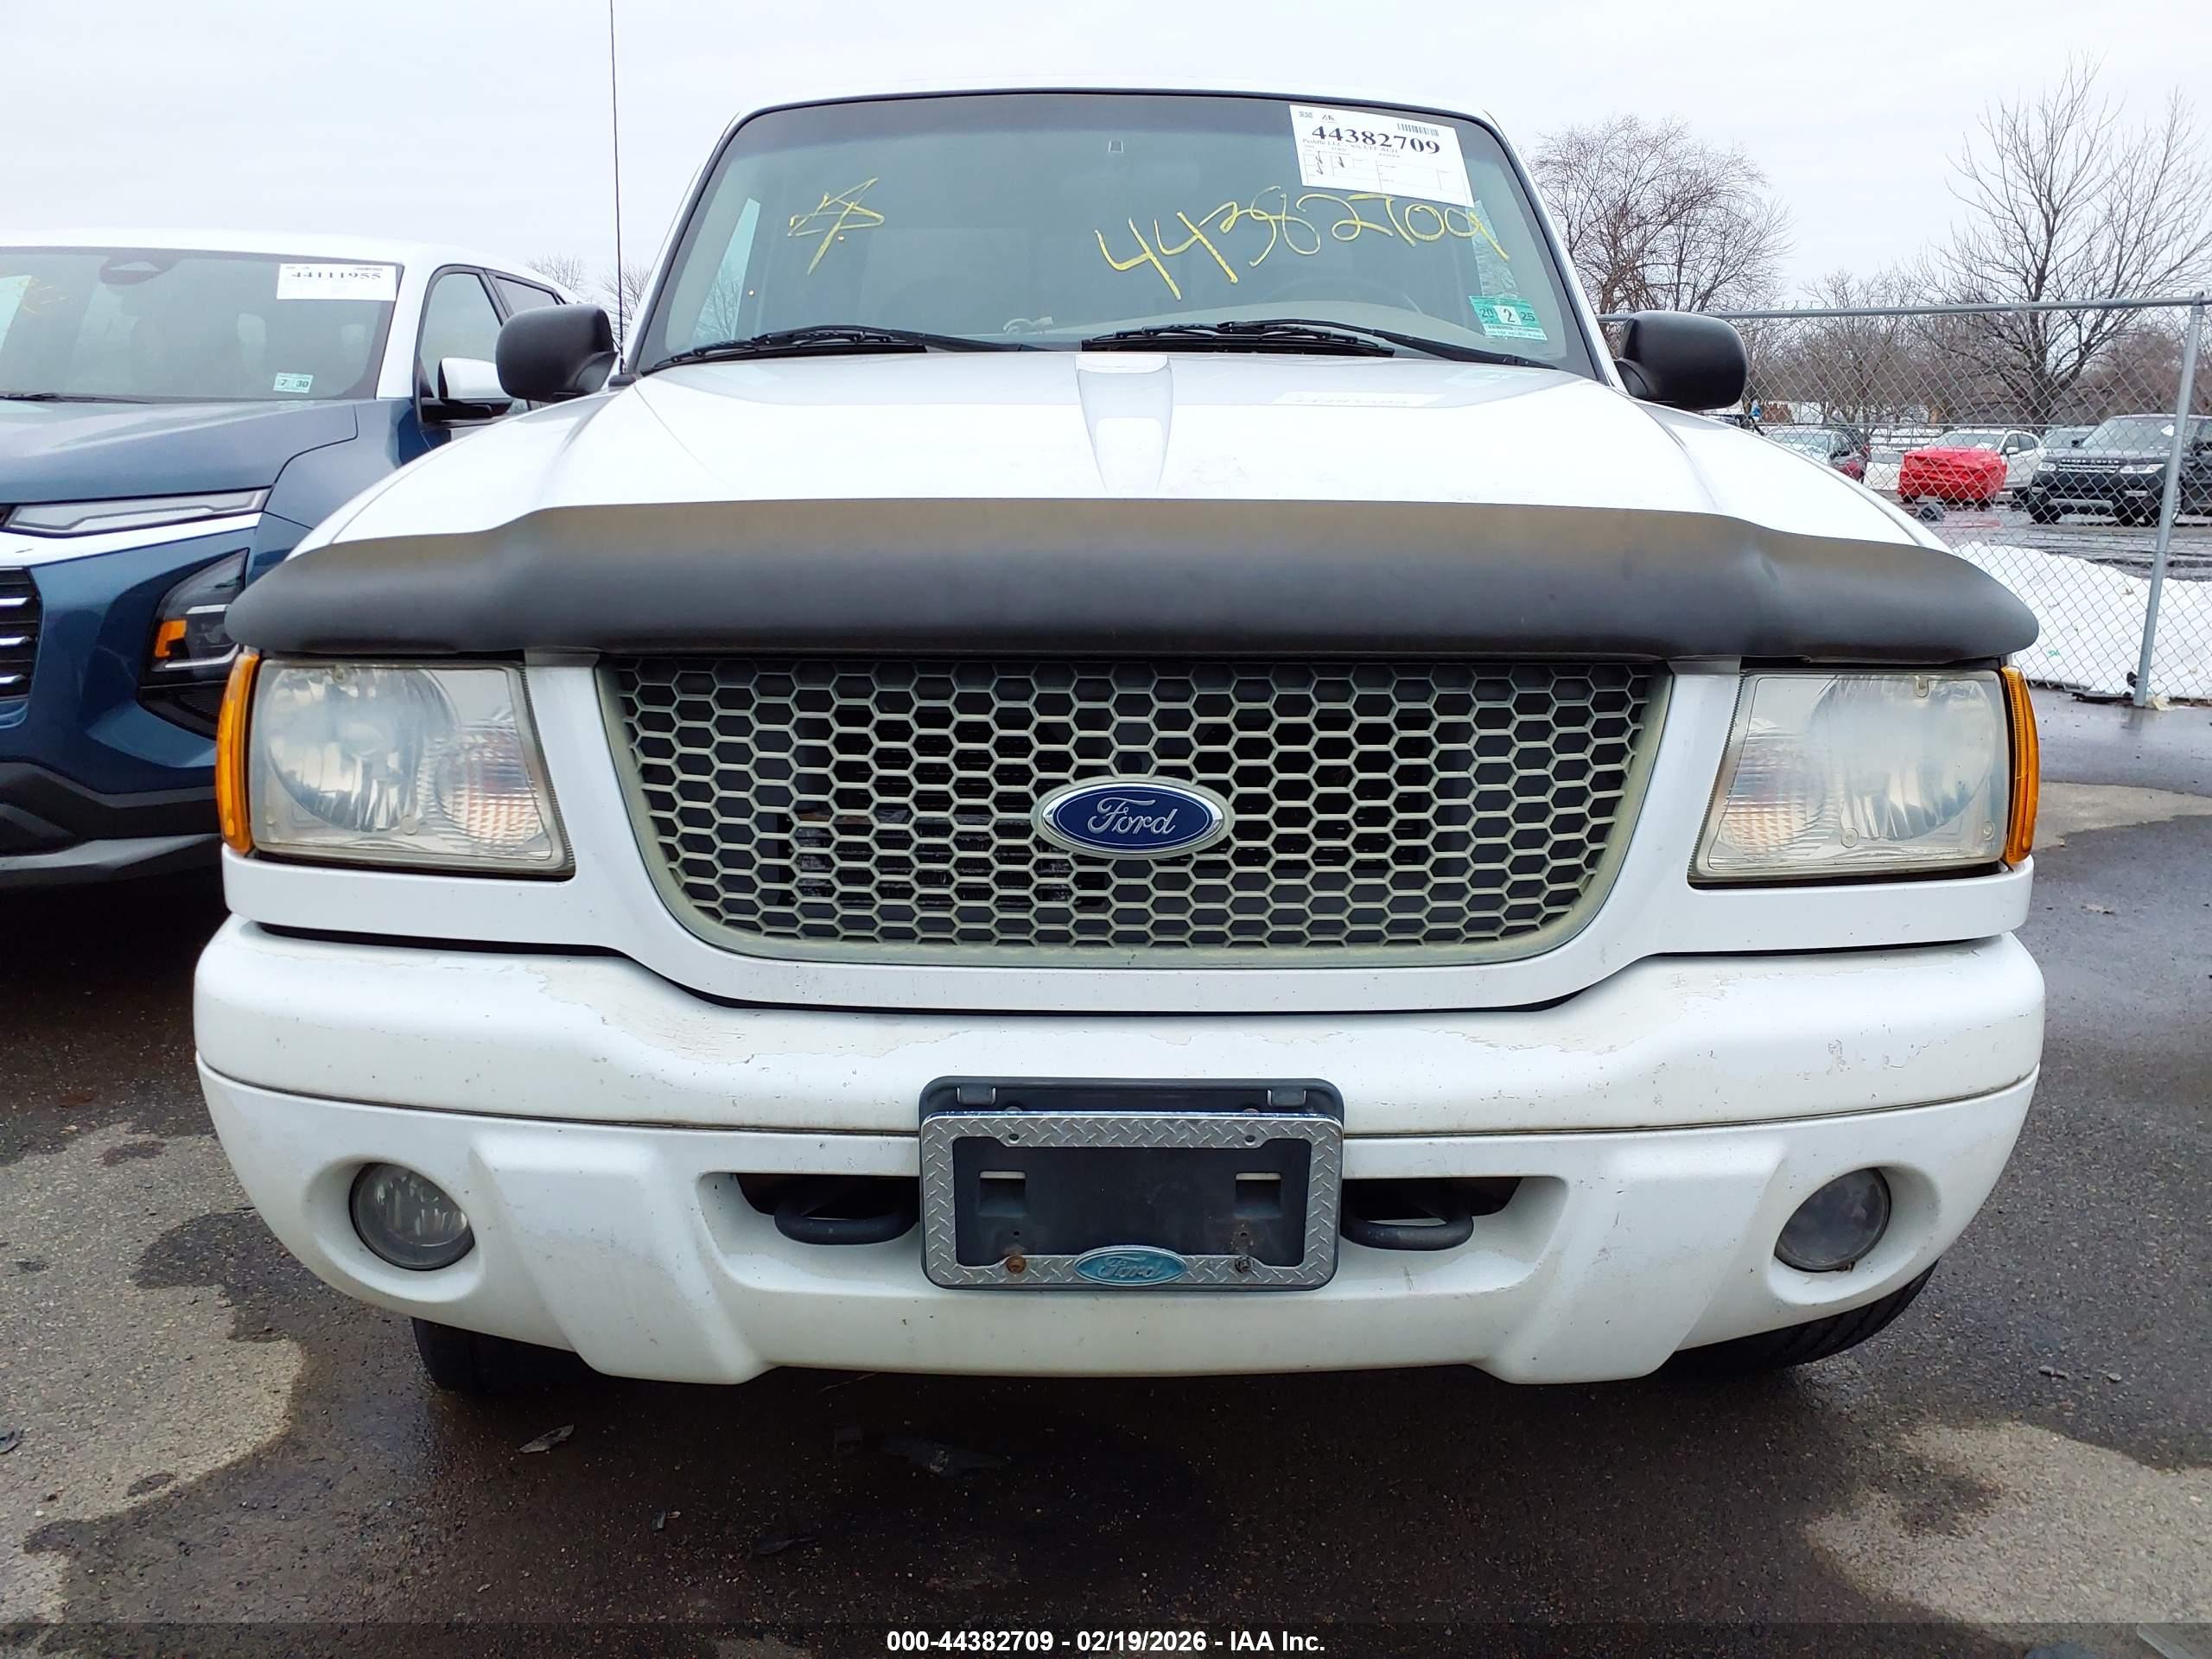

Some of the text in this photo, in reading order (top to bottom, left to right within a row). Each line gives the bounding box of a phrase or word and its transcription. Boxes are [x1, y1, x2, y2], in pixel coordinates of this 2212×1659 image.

[1311, 124, 1441, 156] 44382709
[1093, 185, 1510, 301] 44382709
[1479, 308, 1535, 324] 20 2 25
[1087, 797, 1179, 835] Ford
[1097, 1255, 1161, 1278] Ford
